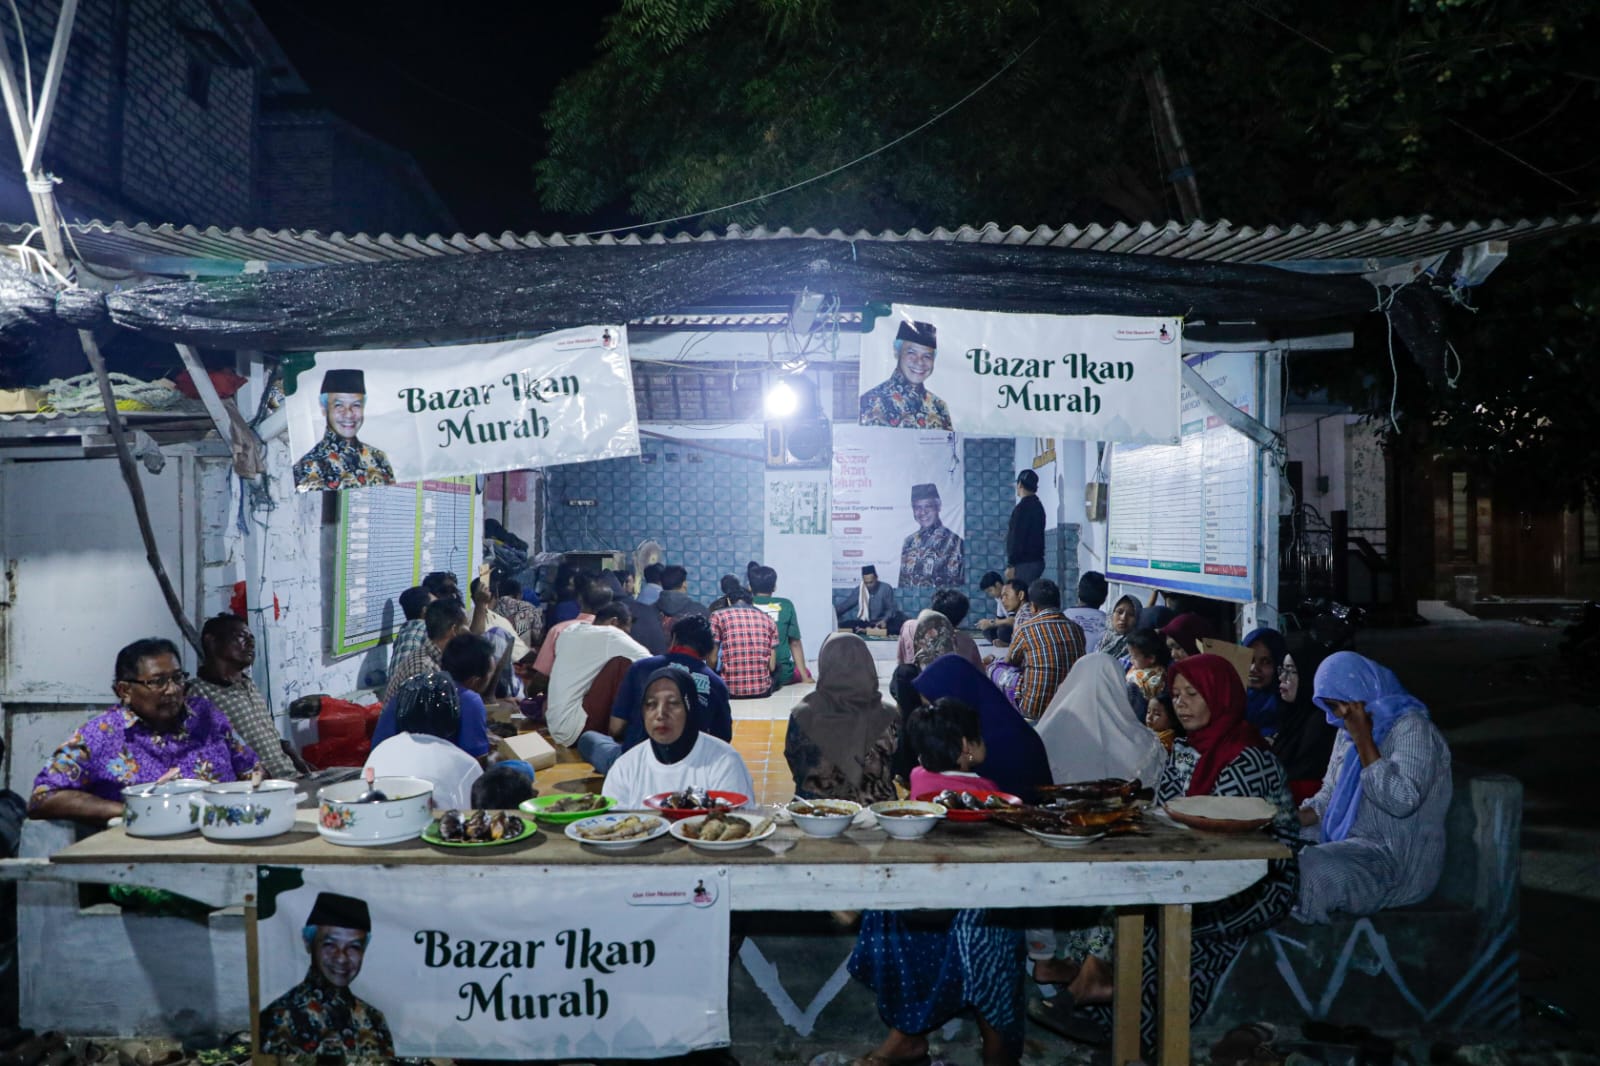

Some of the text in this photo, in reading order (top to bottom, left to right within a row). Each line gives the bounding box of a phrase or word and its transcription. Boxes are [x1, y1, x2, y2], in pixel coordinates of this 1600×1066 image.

[966, 348, 1135, 385] Bazar Ikan
[398, 368, 580, 414] Bazar Ikan
[997, 380, 1101, 415] Murah
[437, 408, 550, 448] Murah
[413, 928, 656, 975] Bazar Ikan
[456, 973, 610, 1022] Murah
